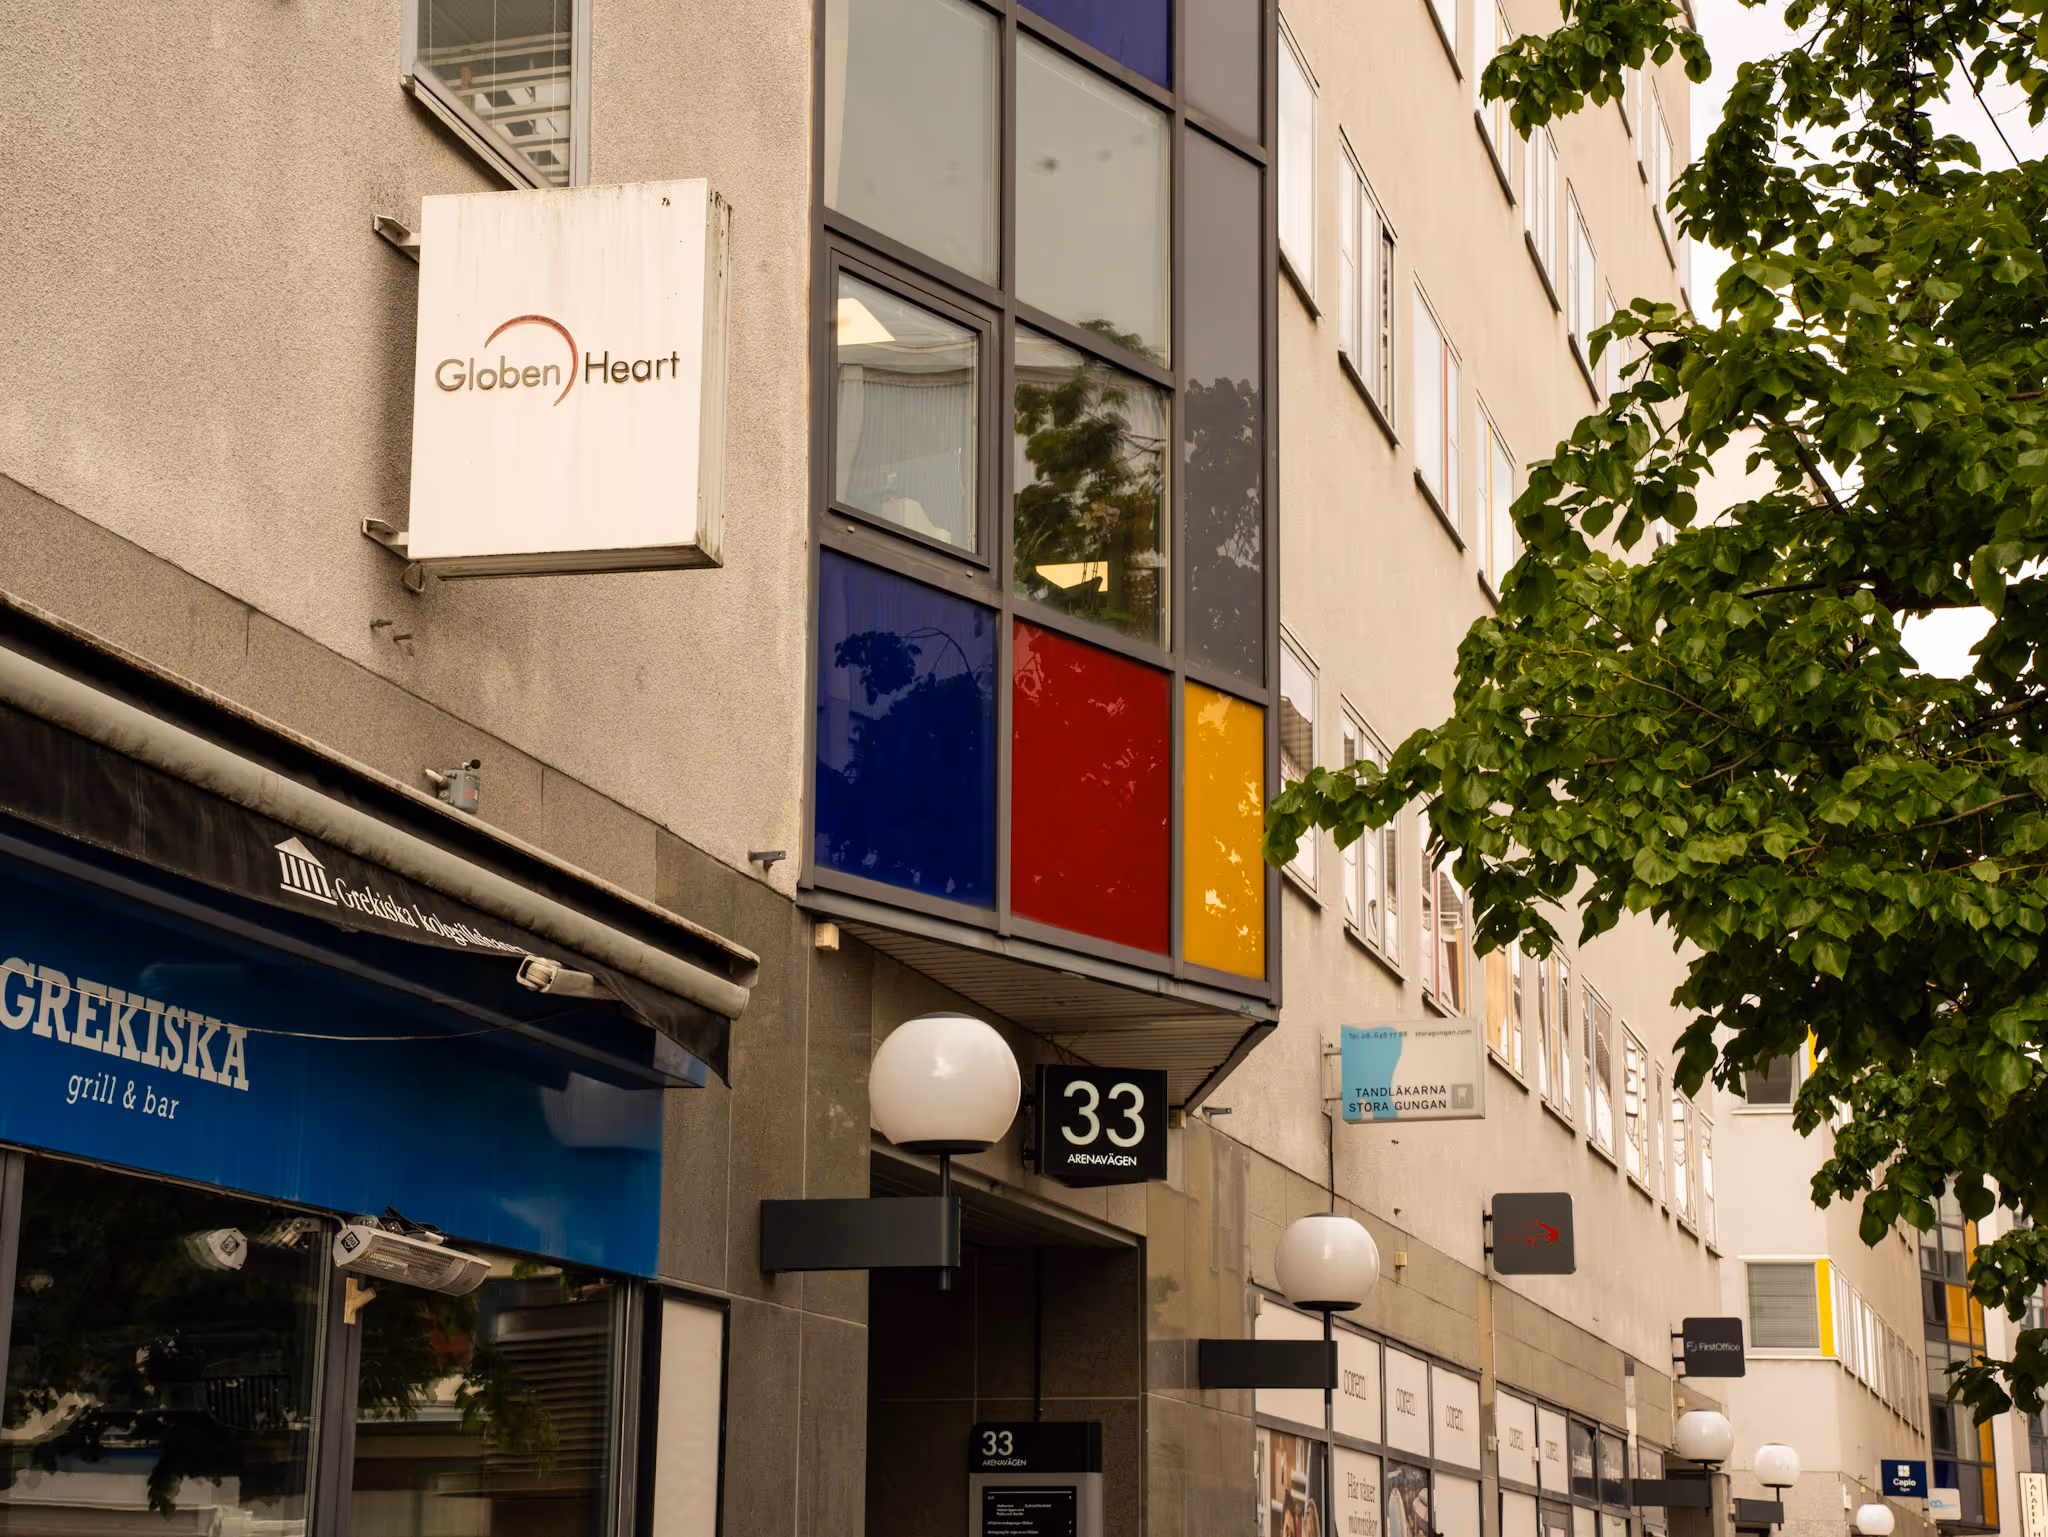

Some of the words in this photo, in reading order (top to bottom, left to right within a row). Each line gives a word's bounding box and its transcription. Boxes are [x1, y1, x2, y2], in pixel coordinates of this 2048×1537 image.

[434, 355, 561, 392] Globen
[584, 350, 681, 384] Heart
[334, 877, 419, 929] Grekiska
[0, 957, 249, 1091] GREKISKA
[66, 1072, 117, 1104] grill
[122, 1080, 136, 1110] &
[143, 1085, 180, 1120] bar
[1355, 1085, 1447, 1098] TANDLÄKARNA
[1061, 1080, 1145, 1148] 33
[1349, 1102, 1389, 1113] STORA
[1394, 1100, 1447, 1111] GUNGAN
[1067, 1153, 1137, 1167] ARENAVÄGEN
[1699, 1342, 1741, 1352] FirstOffice
[982, 1430, 1014, 1456] 33
[982, 1458, 1027, 1467] ARENAVÄGEN
[1347, 1472, 1359, 1500] Här
[1892, 1478, 1917, 1488] Capio
